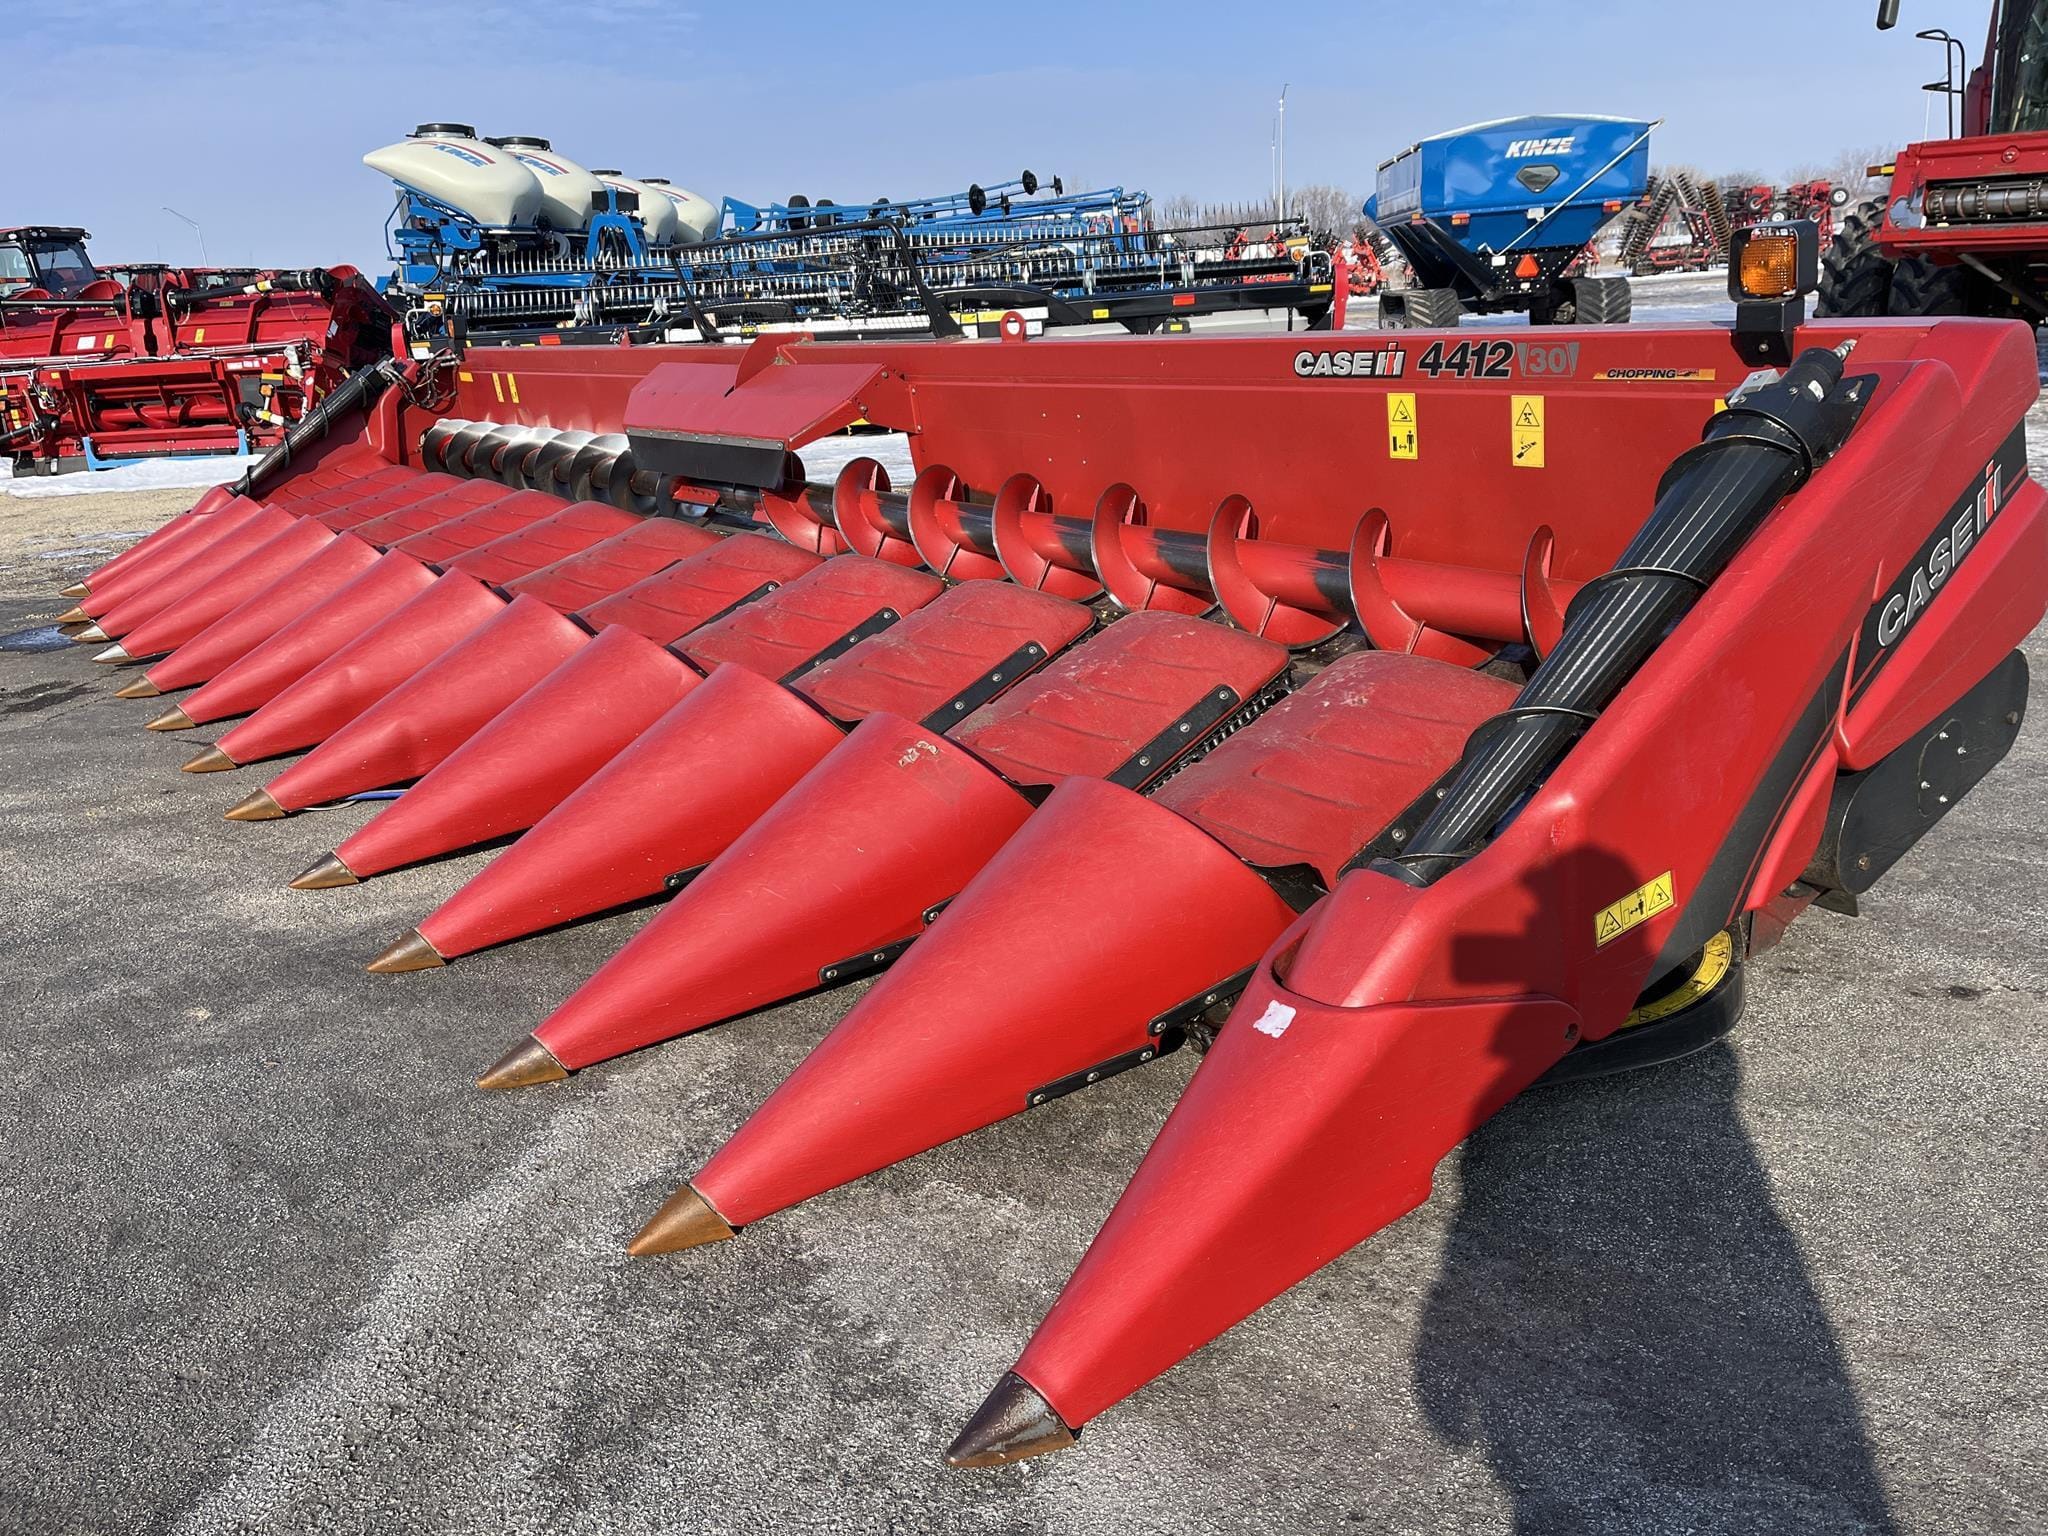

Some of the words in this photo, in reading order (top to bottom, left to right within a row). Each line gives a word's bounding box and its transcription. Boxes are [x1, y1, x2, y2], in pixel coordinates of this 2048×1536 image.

[1505, 136, 1576, 158] KINZE
[1417, 339, 1516, 379] 4412
[1529, 347, 1567, 374] 30
[1606, 368, 1677, 379] CHOPPING
